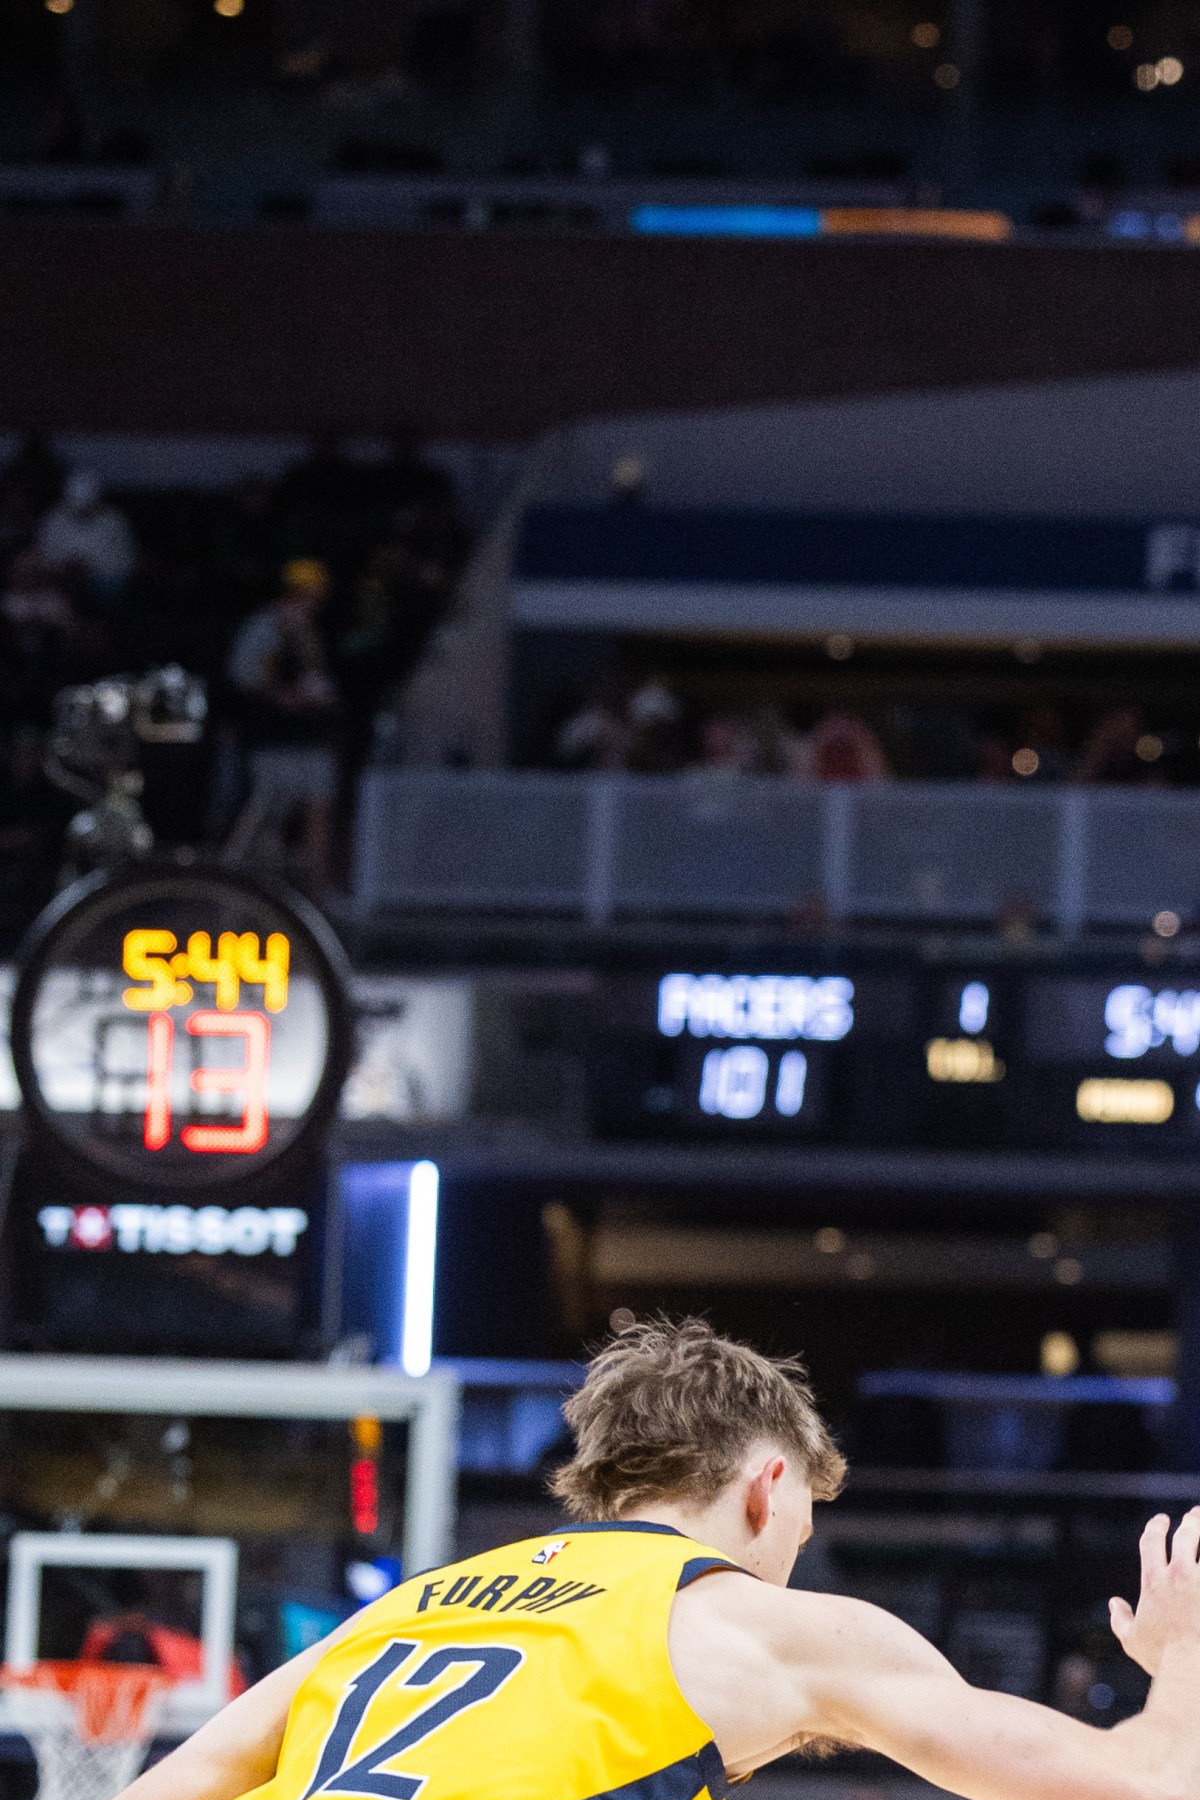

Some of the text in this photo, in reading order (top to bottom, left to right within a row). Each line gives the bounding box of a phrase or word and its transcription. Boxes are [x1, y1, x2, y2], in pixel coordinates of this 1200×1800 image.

[123, 929, 290, 1014] 5:44
[658, 973, 855, 1041] PACERS
[144, 1010, 271, 1153] 13
[699, 1045, 808, 1120] 101
[111, 1203, 309, 1257] TISSOT
[417, 1574, 607, 1614] FURPHY
